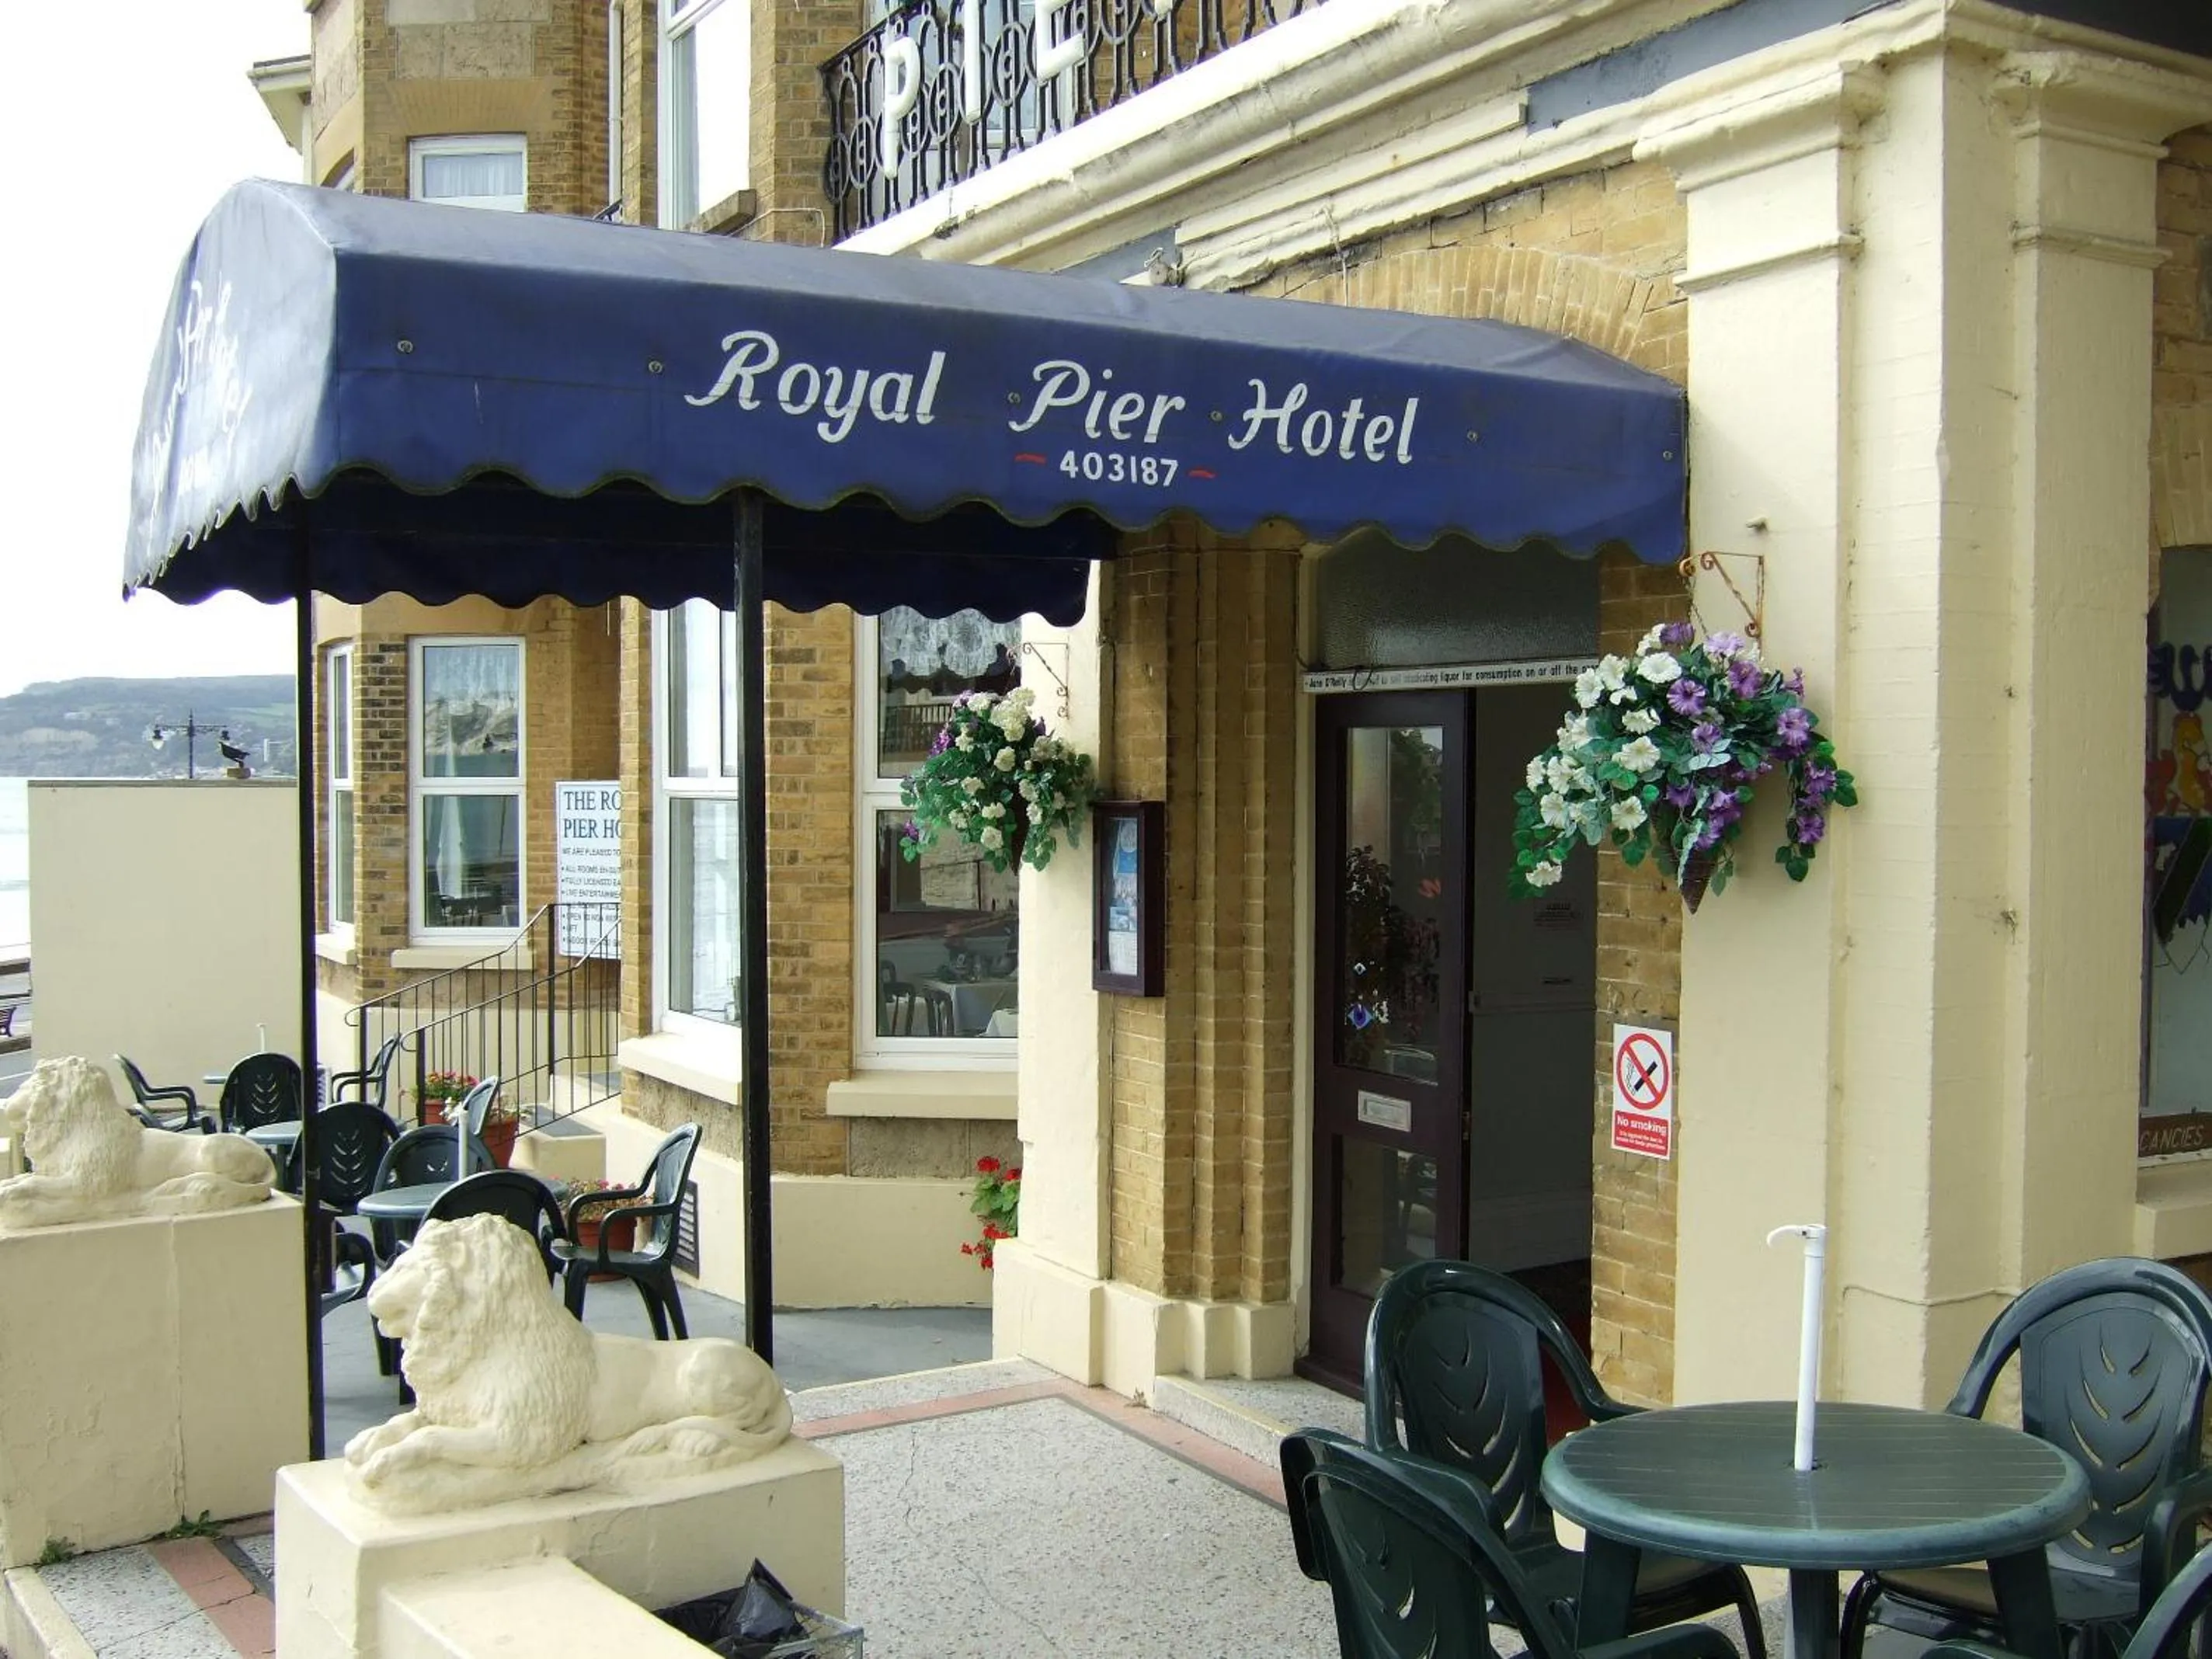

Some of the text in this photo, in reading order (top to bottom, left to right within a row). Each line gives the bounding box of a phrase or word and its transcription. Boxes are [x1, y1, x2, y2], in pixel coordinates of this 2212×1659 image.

[683, 329, 1419, 464] Royal Pier Hotel
[1059, 450, 1179, 487] 403187
[1476, 667, 1523, 680] consumption
[1566, 663, 1578, 675] the
[564, 791, 596, 810] THE
[564, 818, 599, 838] PIER
[1617, 1115, 1668, 1136] No smoking
